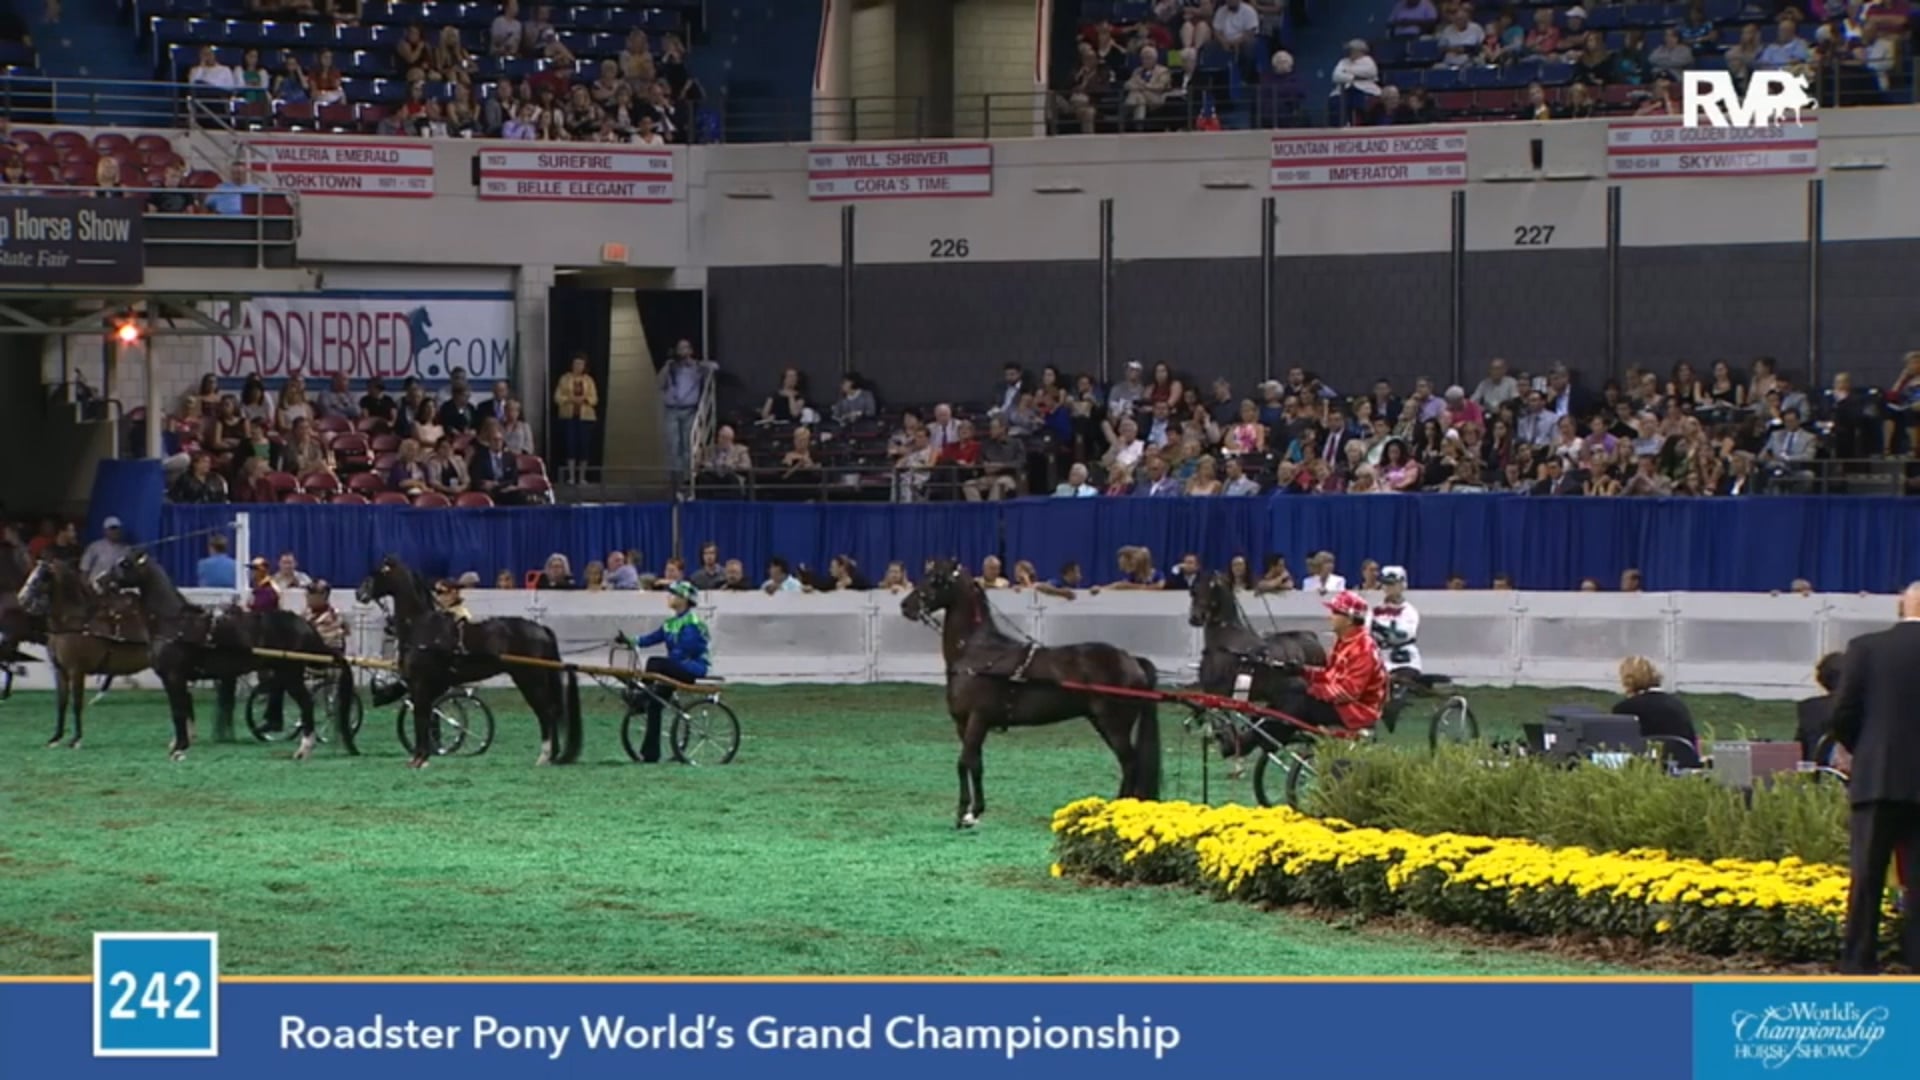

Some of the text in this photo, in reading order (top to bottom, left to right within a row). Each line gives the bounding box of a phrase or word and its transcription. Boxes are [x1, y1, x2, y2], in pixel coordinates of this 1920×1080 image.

[1651, 126, 1784, 143] OUR GOLDEN DUCHESS
[1274, 142, 1329, 156] MOUNTAIN
[1333, 140, 1389, 154] HIGHLAND
[1393, 137, 1439, 151] ENCORE
[275, 147, 399, 163] VALERIA EMERALD
[537, 154, 613, 169] SUREFIRE
[846, 154, 880, 167] WILL
[887, 152, 949, 167] SHRIVER
[1679, 154, 1768, 170] SKYWATCH
[276, 174, 362, 189] YORKTOWN
[1329, 166, 1408, 181] IMPERATOR
[517, 181, 562, 195] BELLE
[569, 181, 635, 196] ELEGANT
[855, 178, 909, 193] CORA'S
[918, 177, 950, 190] TIME
[15, 208, 72, 240] Horse
[78, 209, 130, 242] Show
[1514, 225, 1555, 245] 227
[930, 238, 969, 257] 226
[37, 249, 70, 267] Fair
